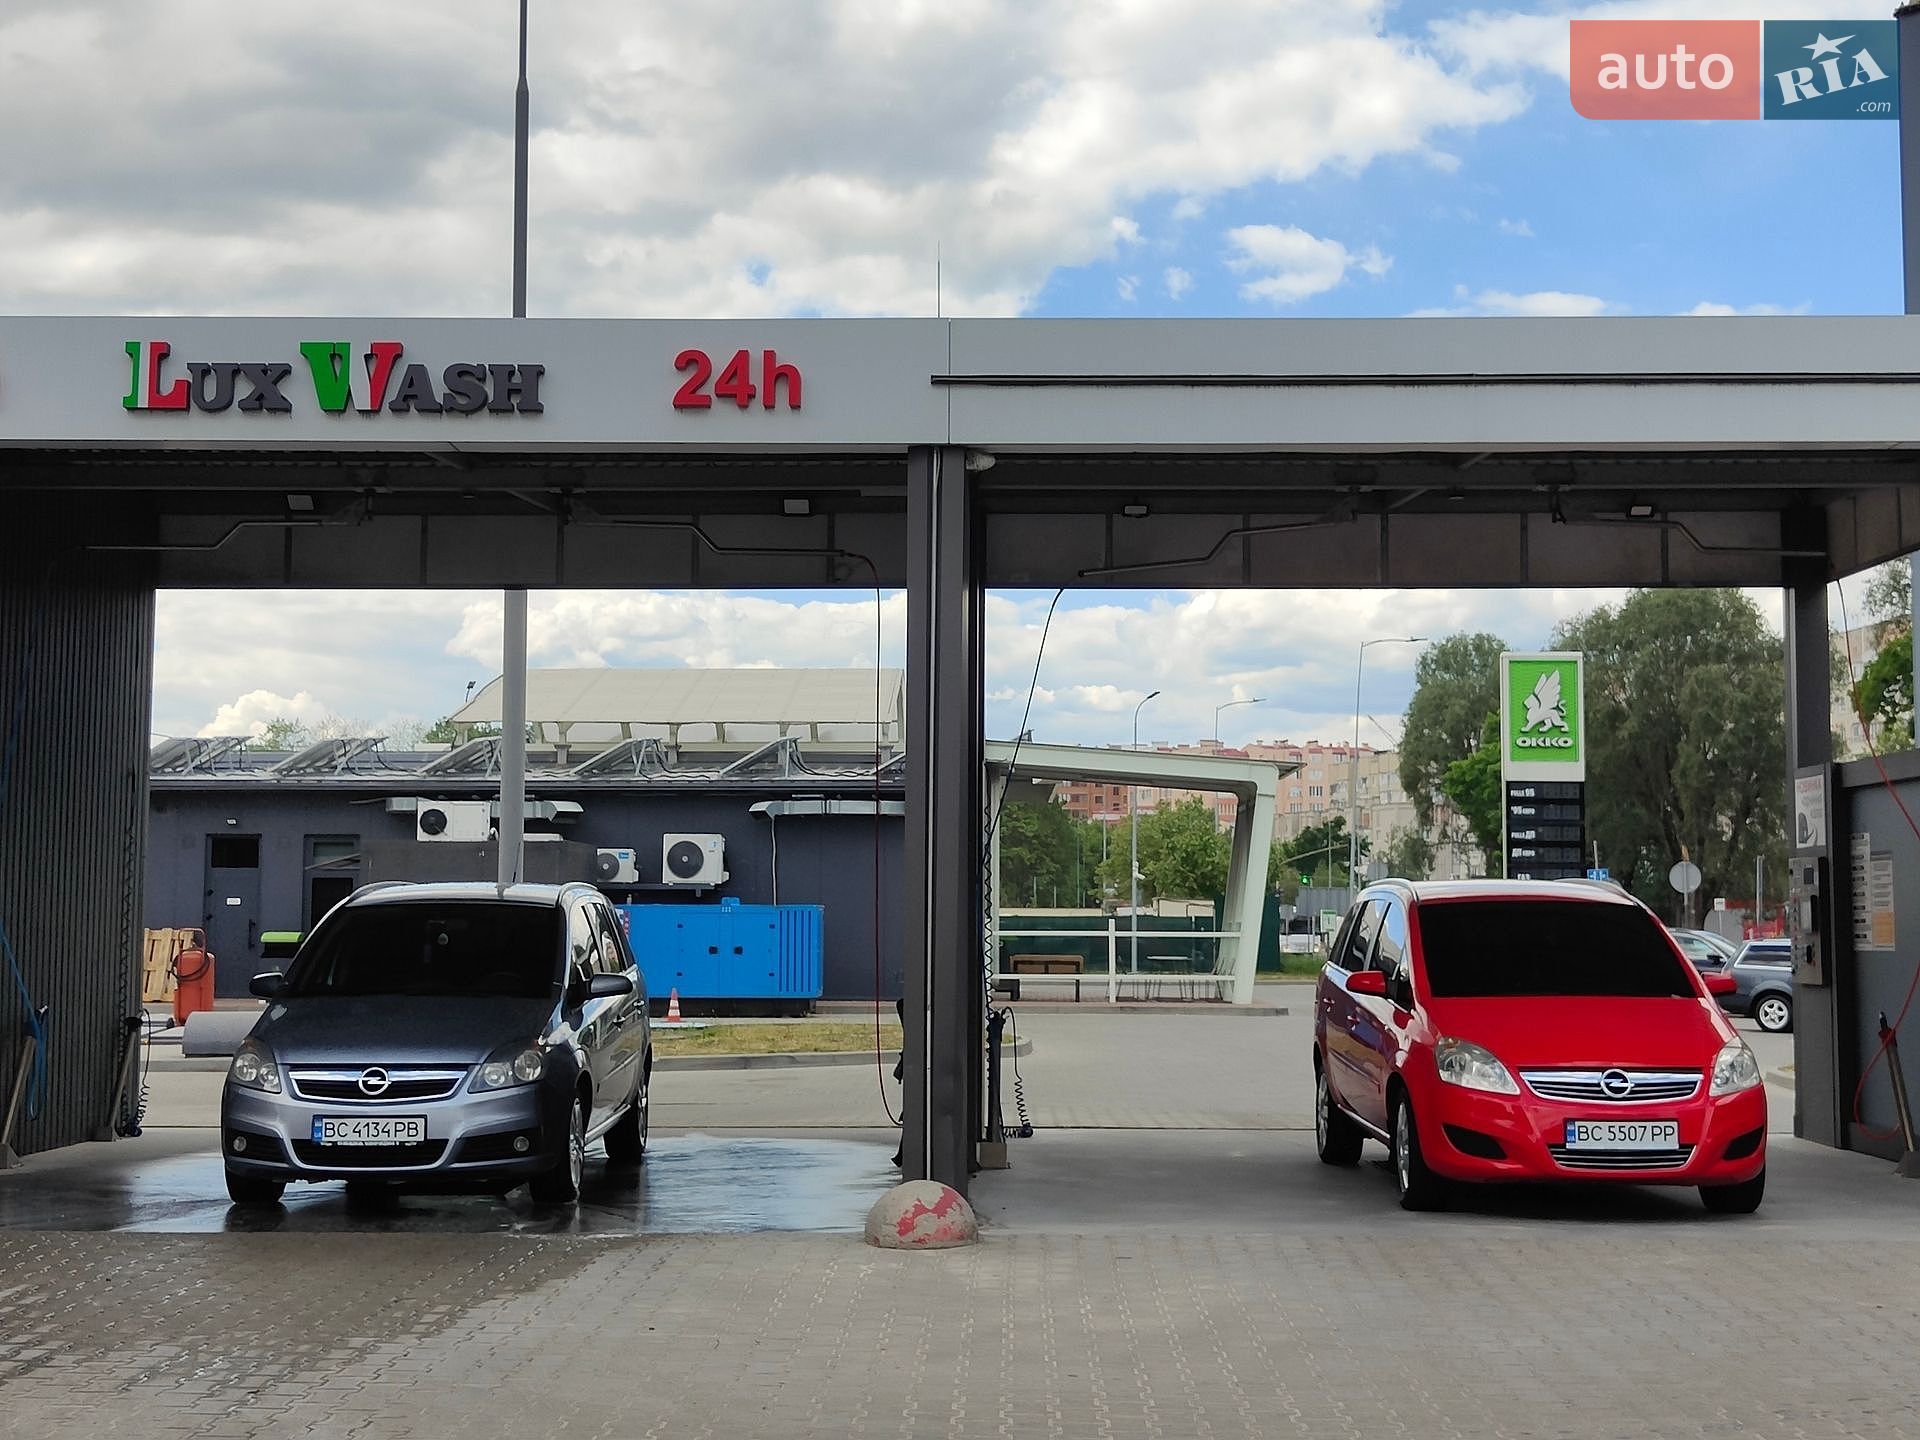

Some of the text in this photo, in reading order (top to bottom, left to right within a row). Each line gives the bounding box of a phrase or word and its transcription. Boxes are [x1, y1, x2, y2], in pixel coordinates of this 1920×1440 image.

[672, 348, 802, 409] 24h
[1516, 737, 1573, 747] OKKO
[324, 1122, 348, 1139] BC
[352, 1121, 391, 1138] 4134
[395, 1121, 419, 1138] PB
[1577, 1125, 1675, 1142] BC 5507 PP
